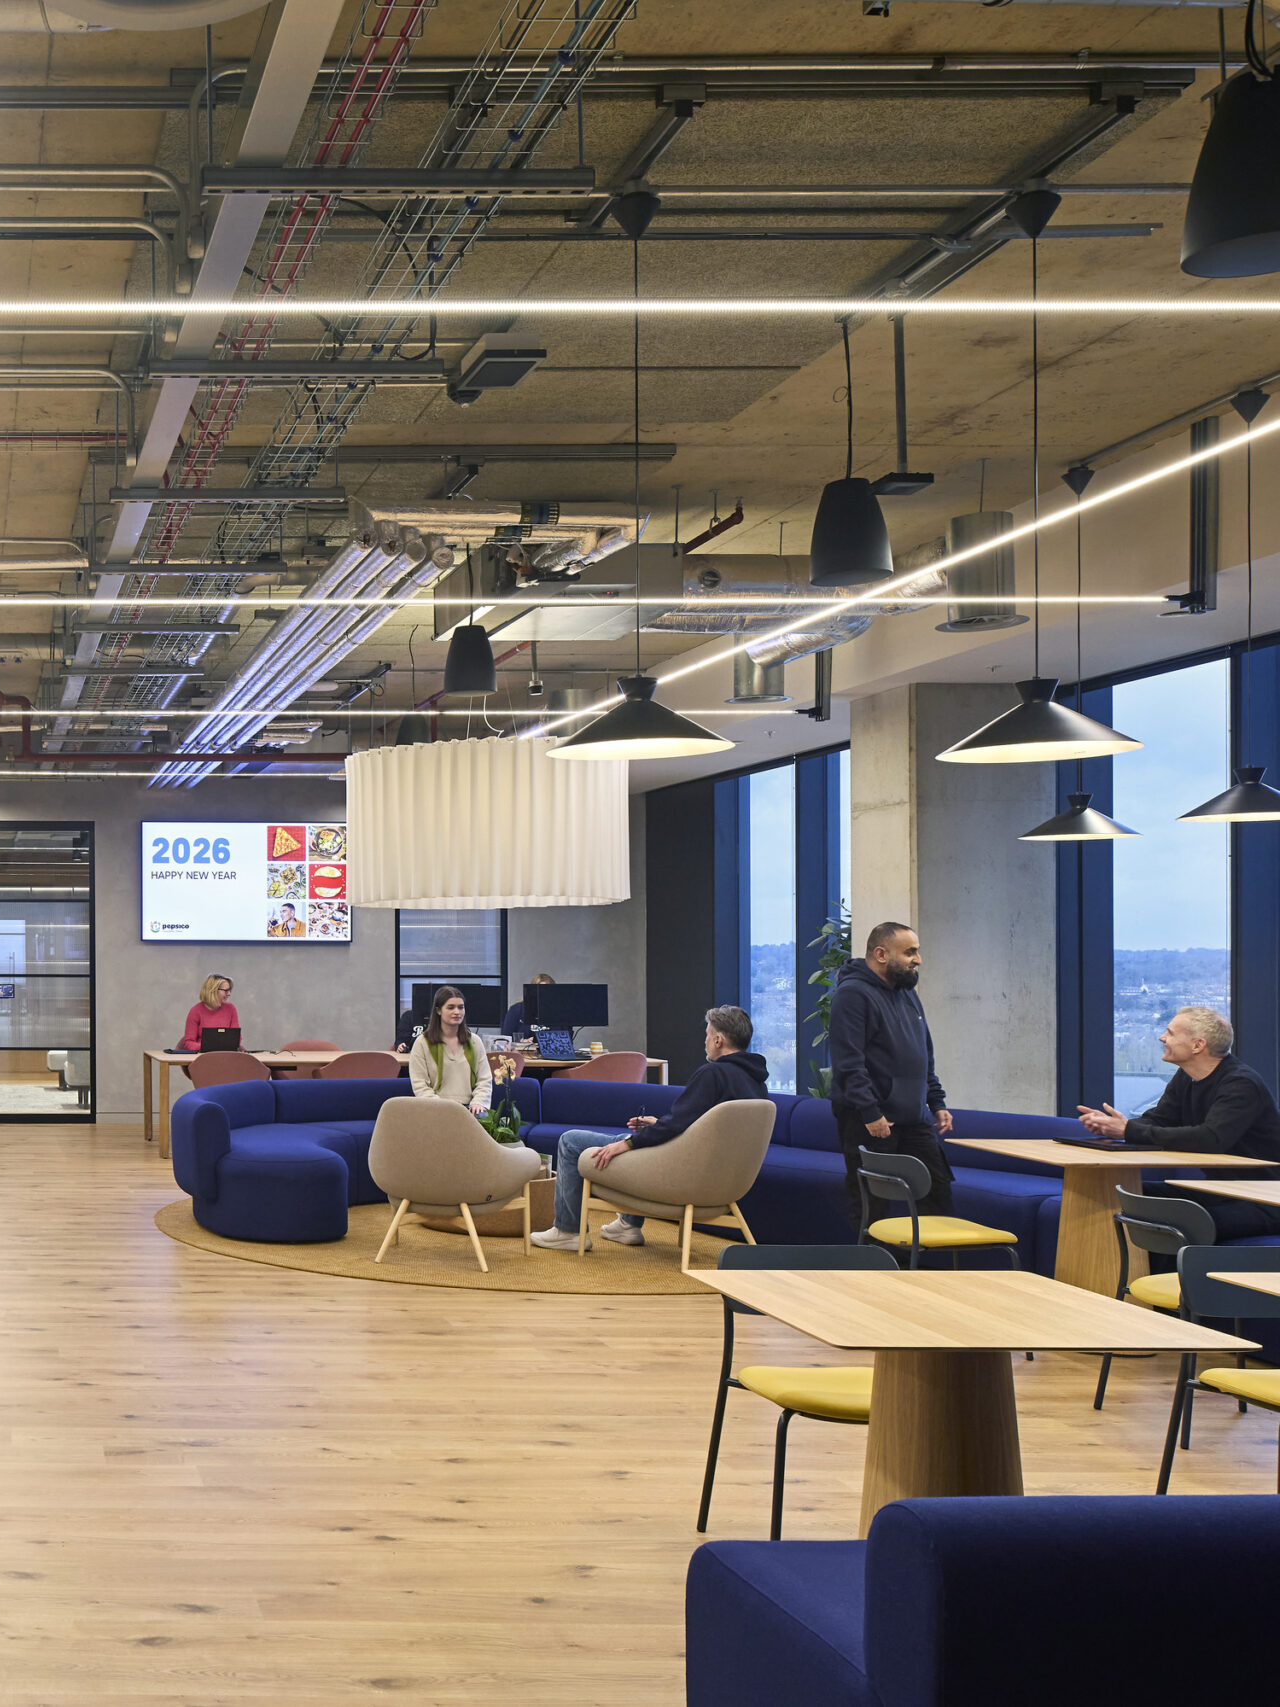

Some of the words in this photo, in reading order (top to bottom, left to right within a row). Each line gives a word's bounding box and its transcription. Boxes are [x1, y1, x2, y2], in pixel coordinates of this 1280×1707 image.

[152, 837, 231, 864] 2026
[151, 871, 183, 880] HAPPY
[186, 871, 209, 880] NEW
[211, 871, 237, 880] YEAR
